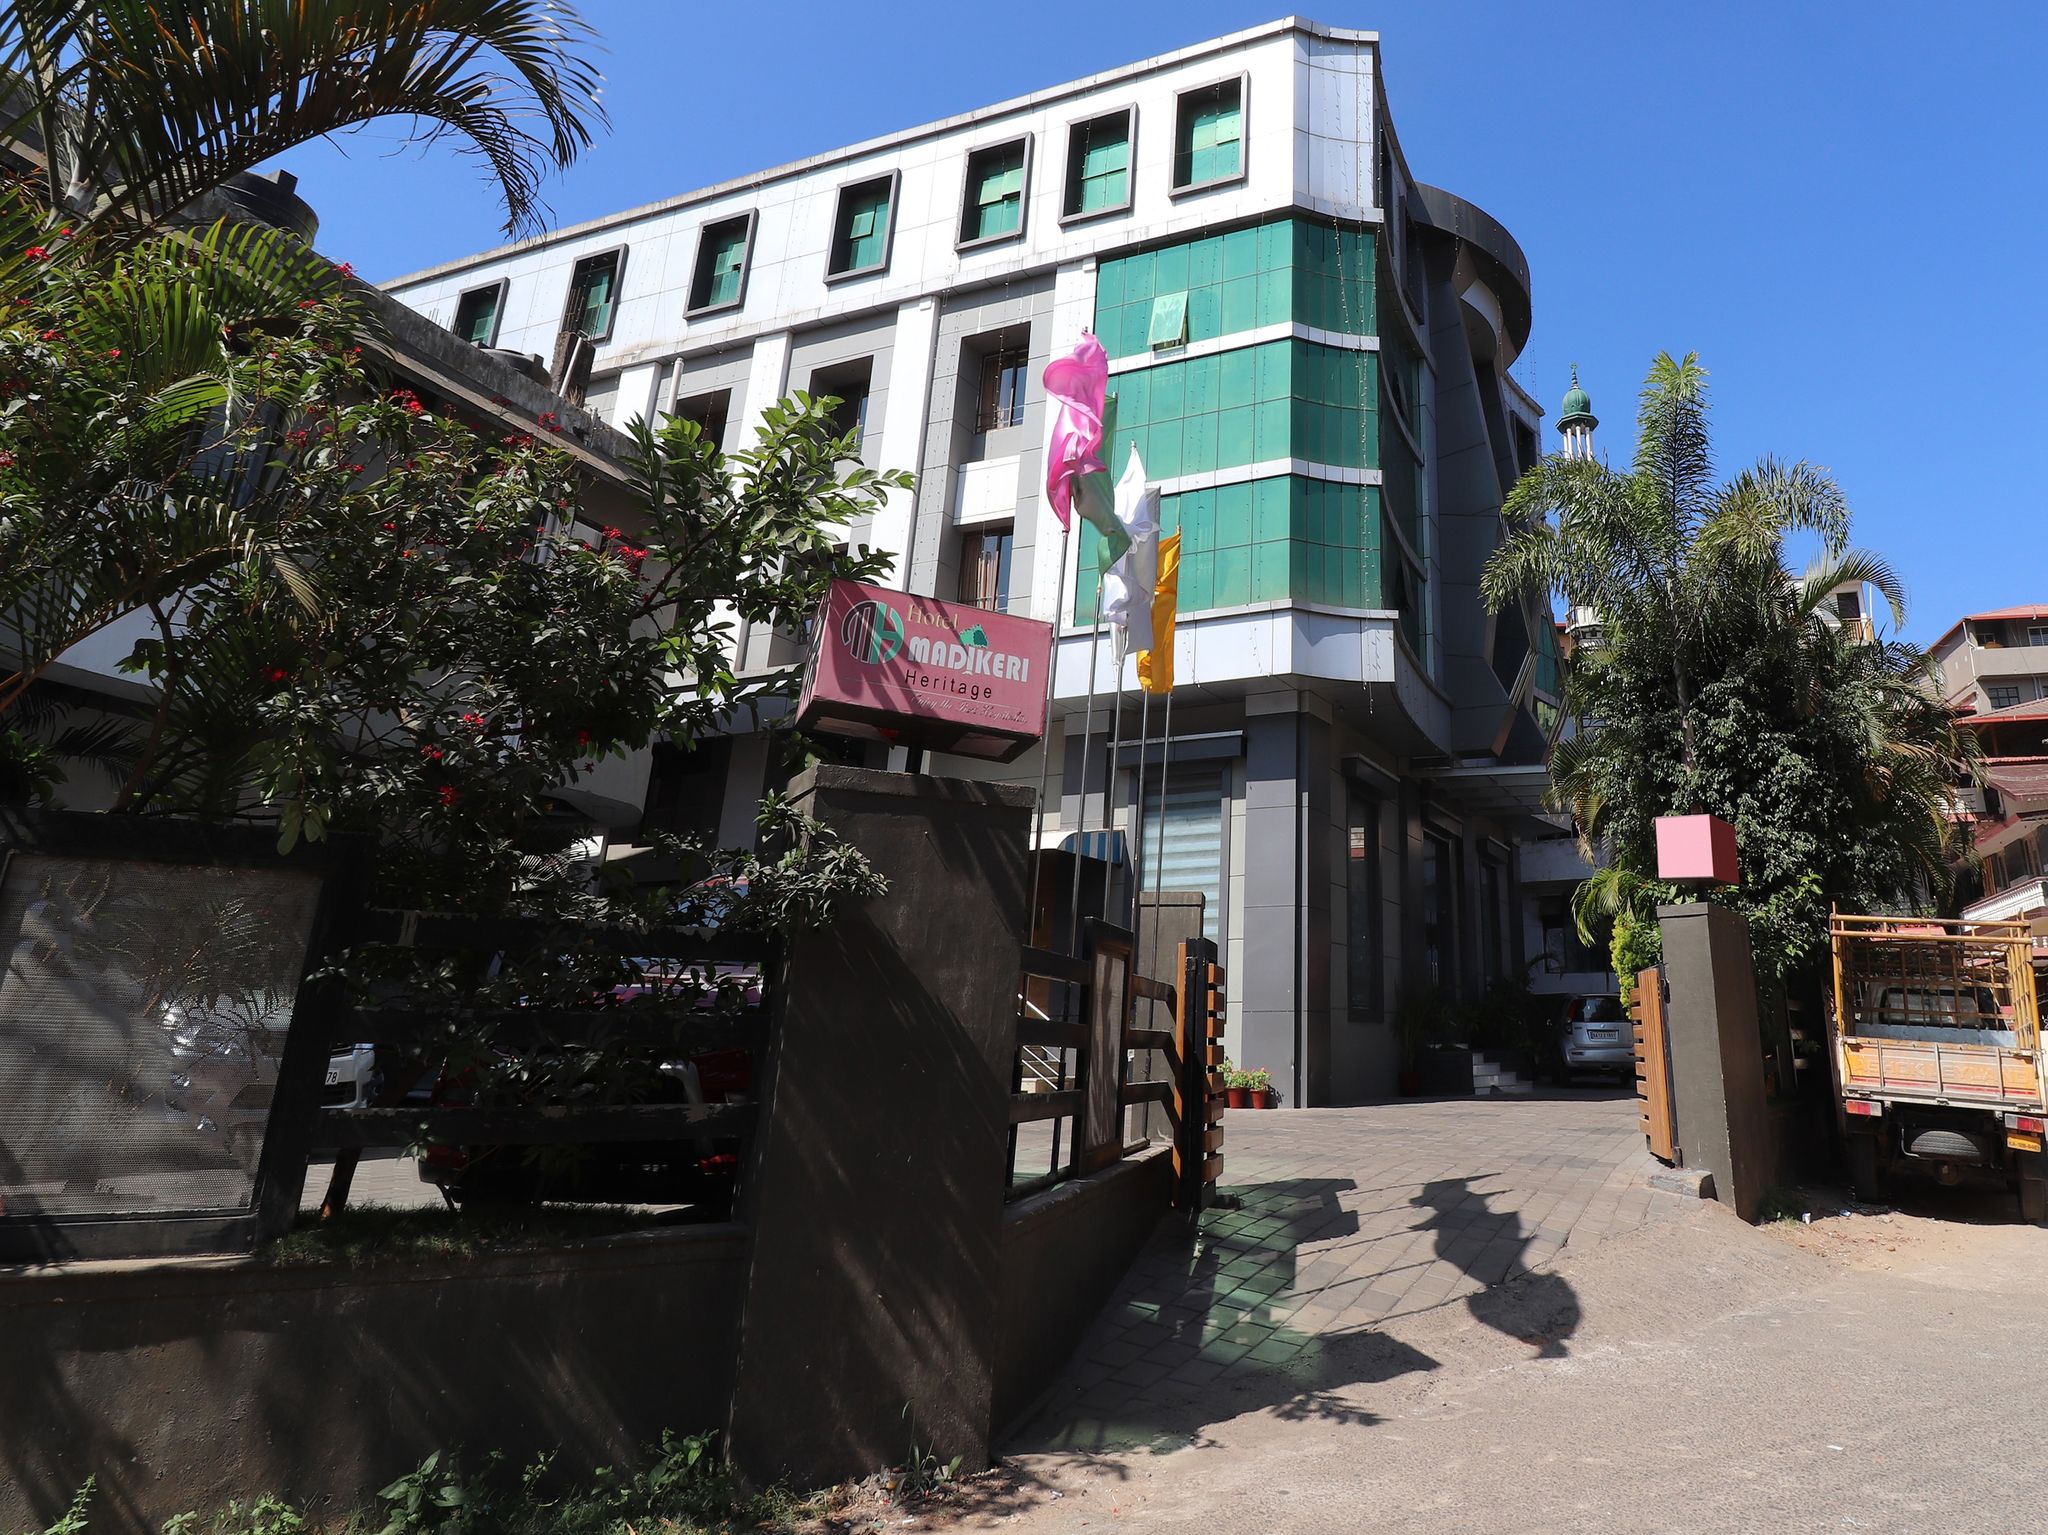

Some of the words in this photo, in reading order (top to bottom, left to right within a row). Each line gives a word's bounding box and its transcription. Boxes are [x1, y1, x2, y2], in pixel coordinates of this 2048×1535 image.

[907, 603, 959, 631] Hotel
[908, 636, 1029, 683] MADIKERI
[905, 669, 992, 700] Heritage
